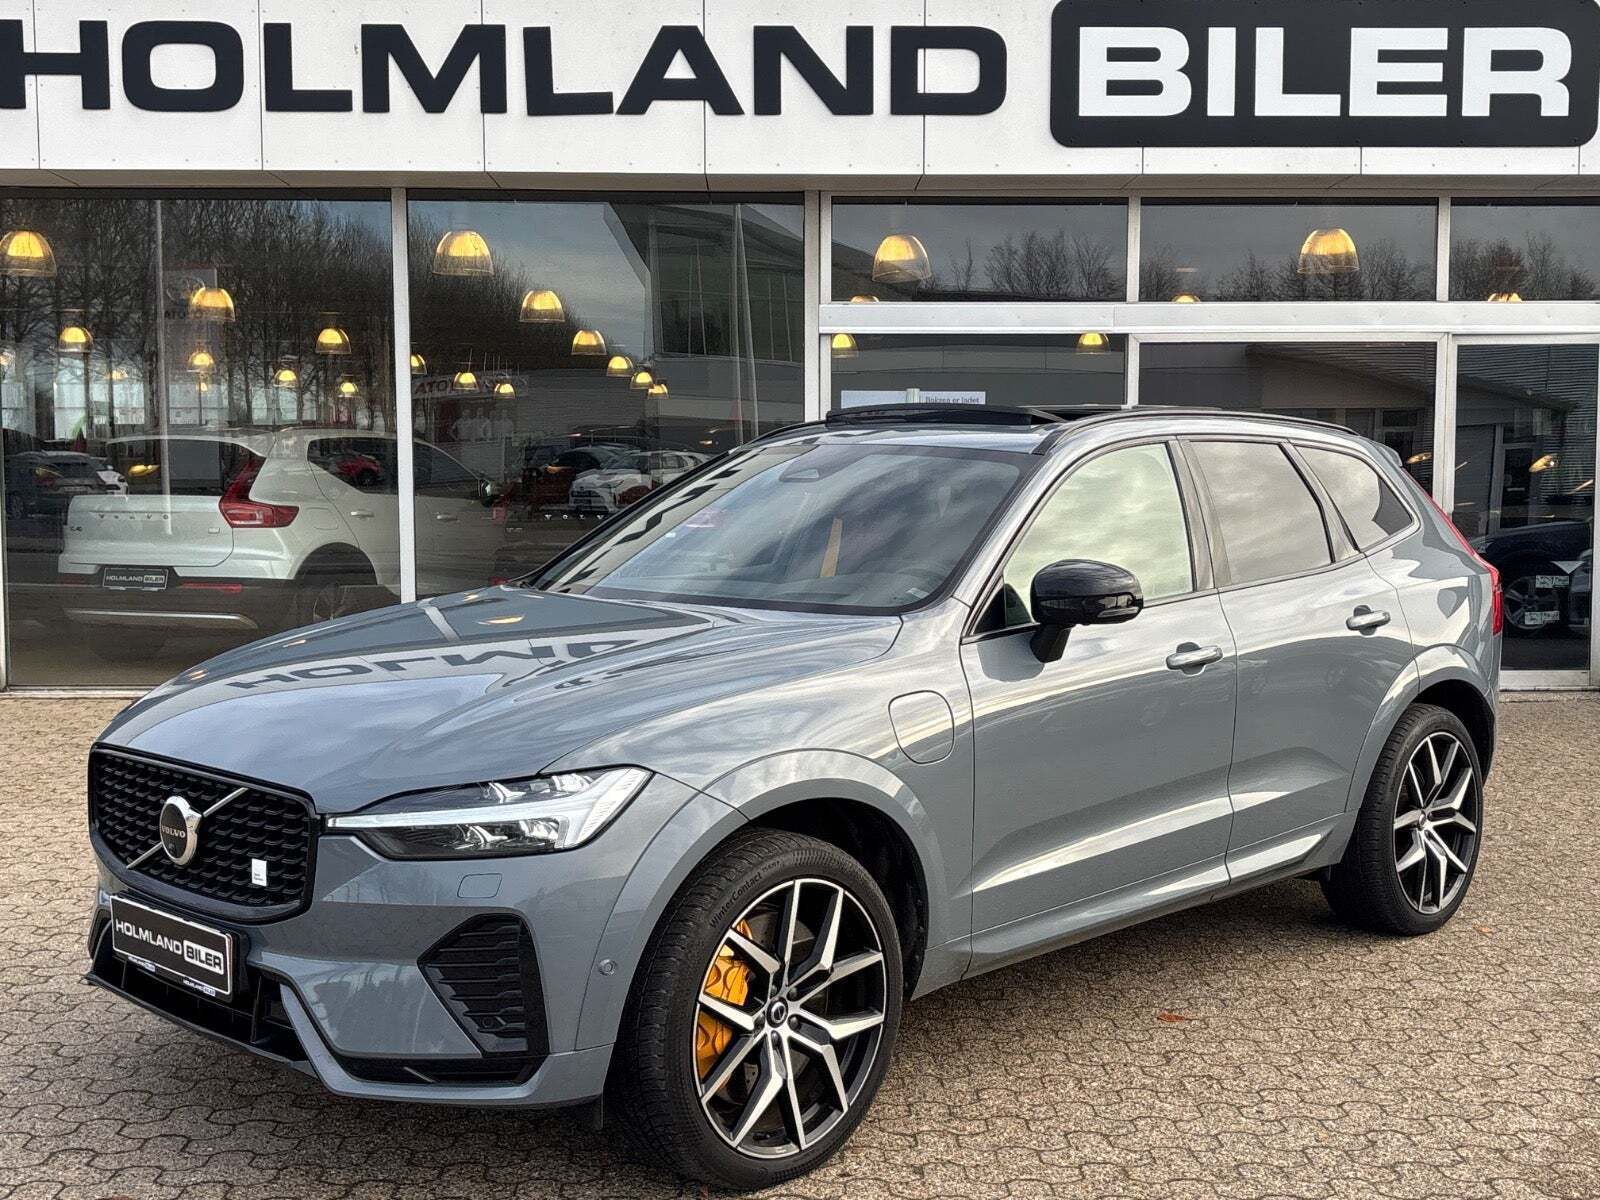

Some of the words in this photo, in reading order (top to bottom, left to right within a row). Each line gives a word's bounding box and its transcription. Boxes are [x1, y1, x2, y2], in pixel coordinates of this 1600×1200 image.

[0, 19, 1007, 117] HOLMLAND
[1078, 26, 1573, 118] BILER
[161, 825, 186, 838] VOLVO
[115, 918, 183, 955] HOLMLAND
[186, 945, 222, 970] BILER
